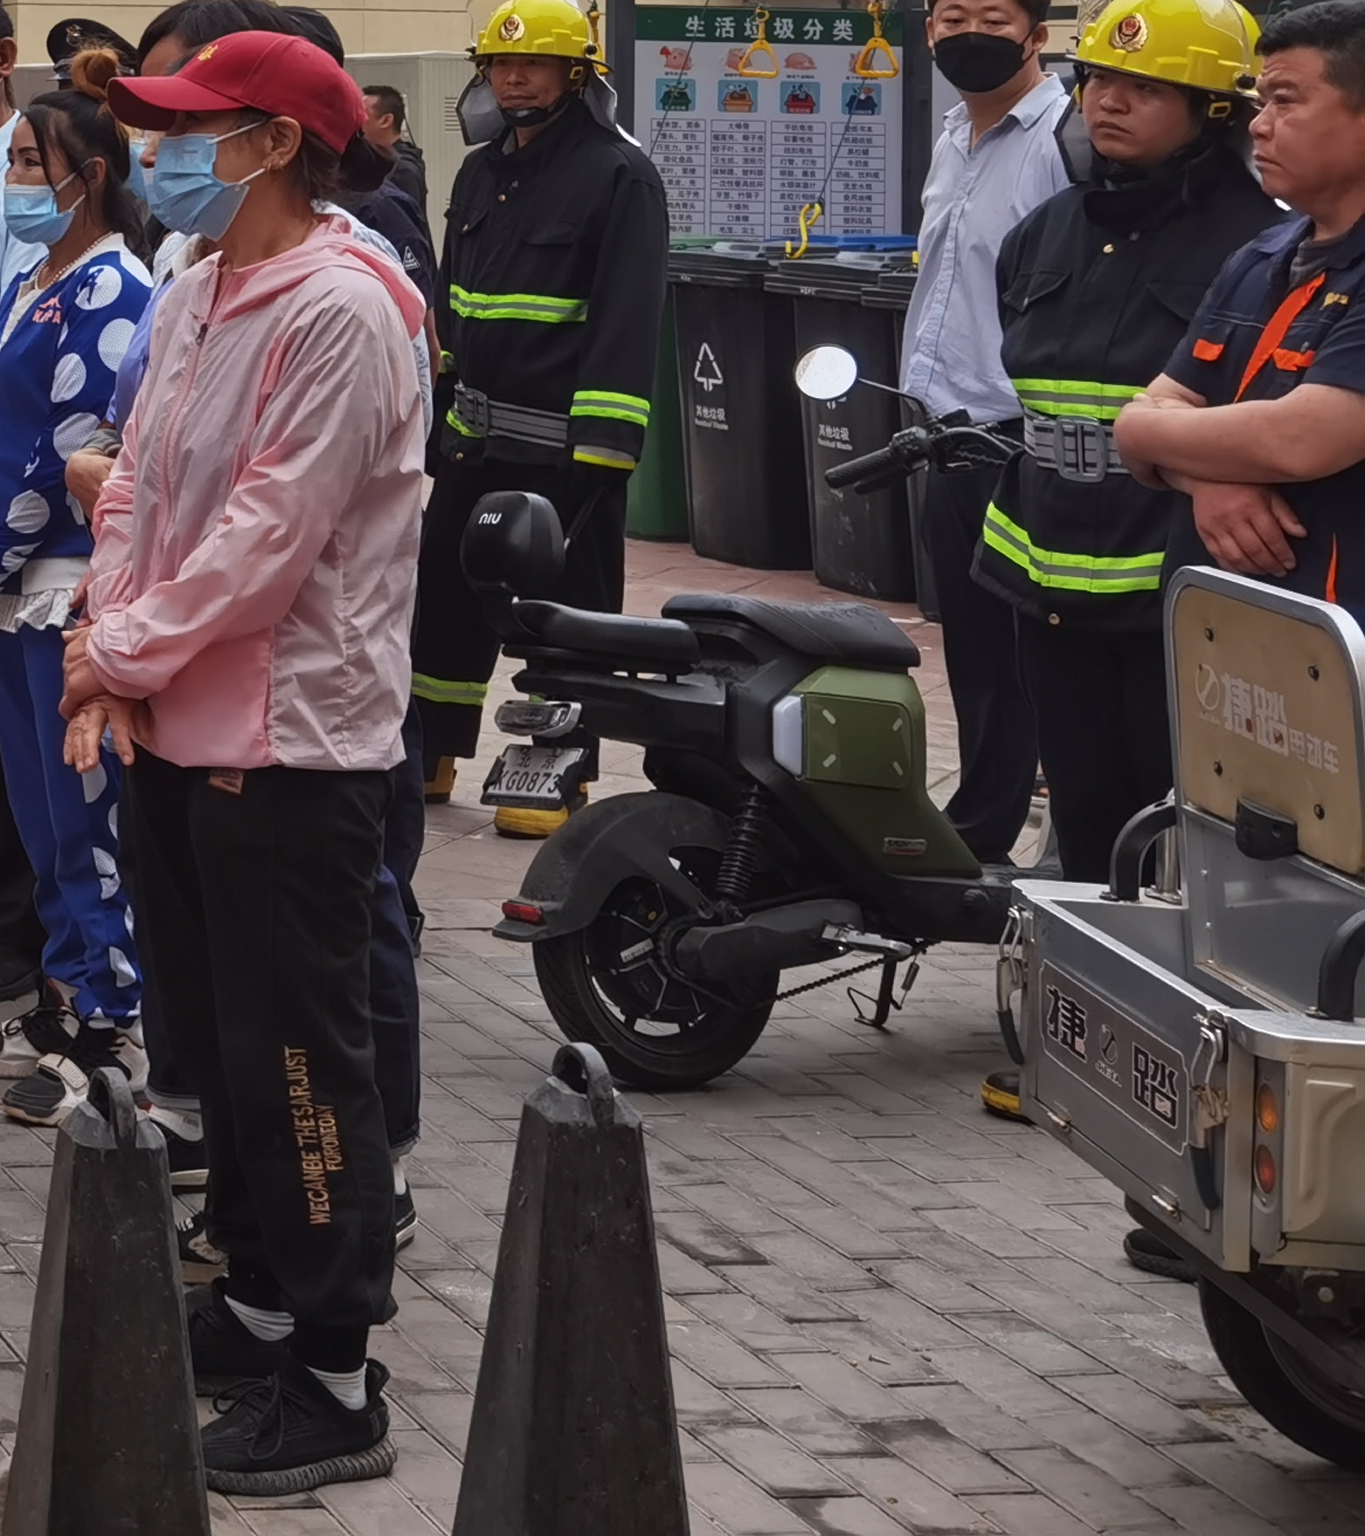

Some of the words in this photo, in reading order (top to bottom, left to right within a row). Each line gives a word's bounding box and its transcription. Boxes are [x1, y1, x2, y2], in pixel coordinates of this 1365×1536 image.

[685, 15, 854, 41] 生活垃圾分类
[695, 405, 726, 421] 其他垃圾
[819, 424, 850, 441] 其他垃圾
